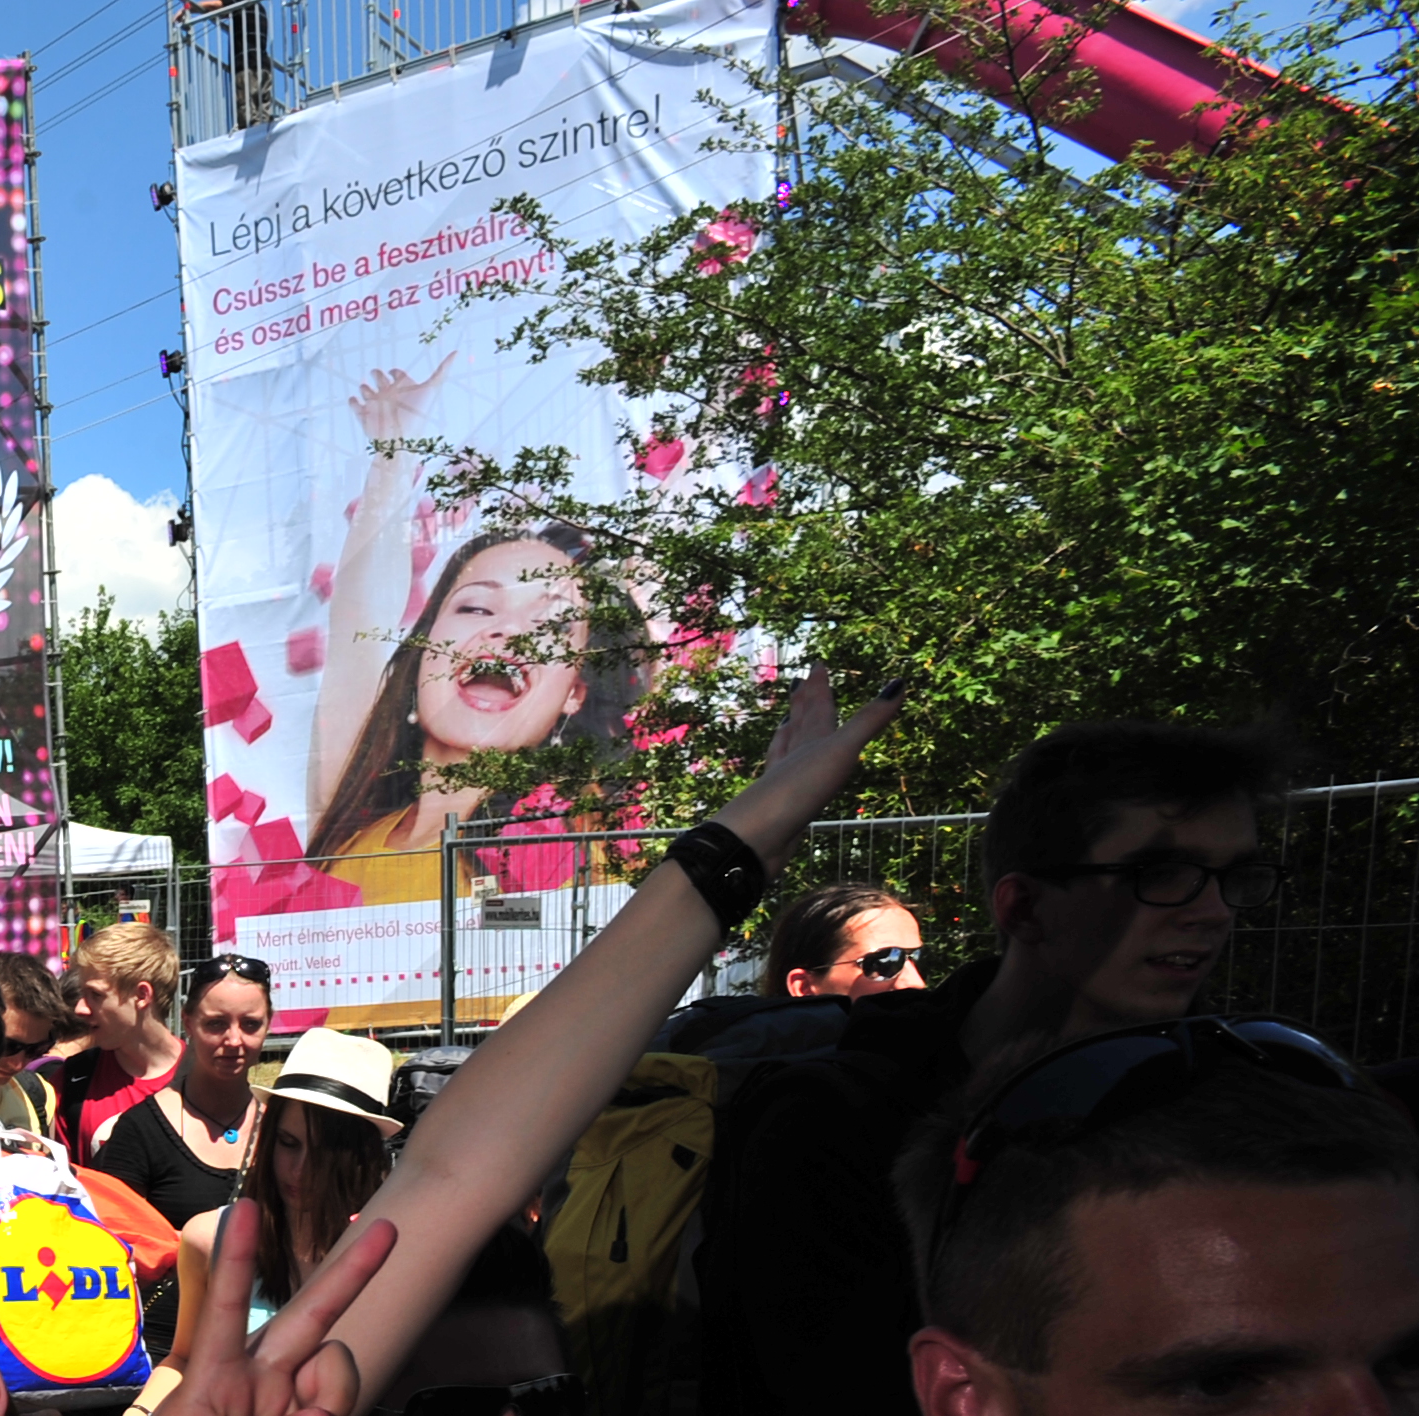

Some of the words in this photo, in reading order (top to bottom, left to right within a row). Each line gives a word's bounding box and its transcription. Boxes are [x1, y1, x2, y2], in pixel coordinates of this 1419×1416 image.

[210, 202, 283, 257] Lépj
[291, 206, 312, 233] a
[321, 138, 506, 224] következő
[517, 94, 661, 168] szintre!
[212, 271, 306, 317] Csússz
[313, 256, 347, 286] be
[354, 255, 370, 277] a
[376, 209, 528, 272] fesztiválra
[214, 325, 244, 355] és
[251, 308, 312, 347] oszd
[318, 293, 379, 330] meg
[386, 285, 421, 313] az
[428, 247, 555, 300] élményt!
[257, 930, 293, 949] Mert
[297, 919, 400, 945] élményekből
[405, 917, 459, 936] sose
[269, 957, 301, 973] gyütt.
[306, 955, 341, 970] Veled
[1, 1247, 131, 1310] LIDL
